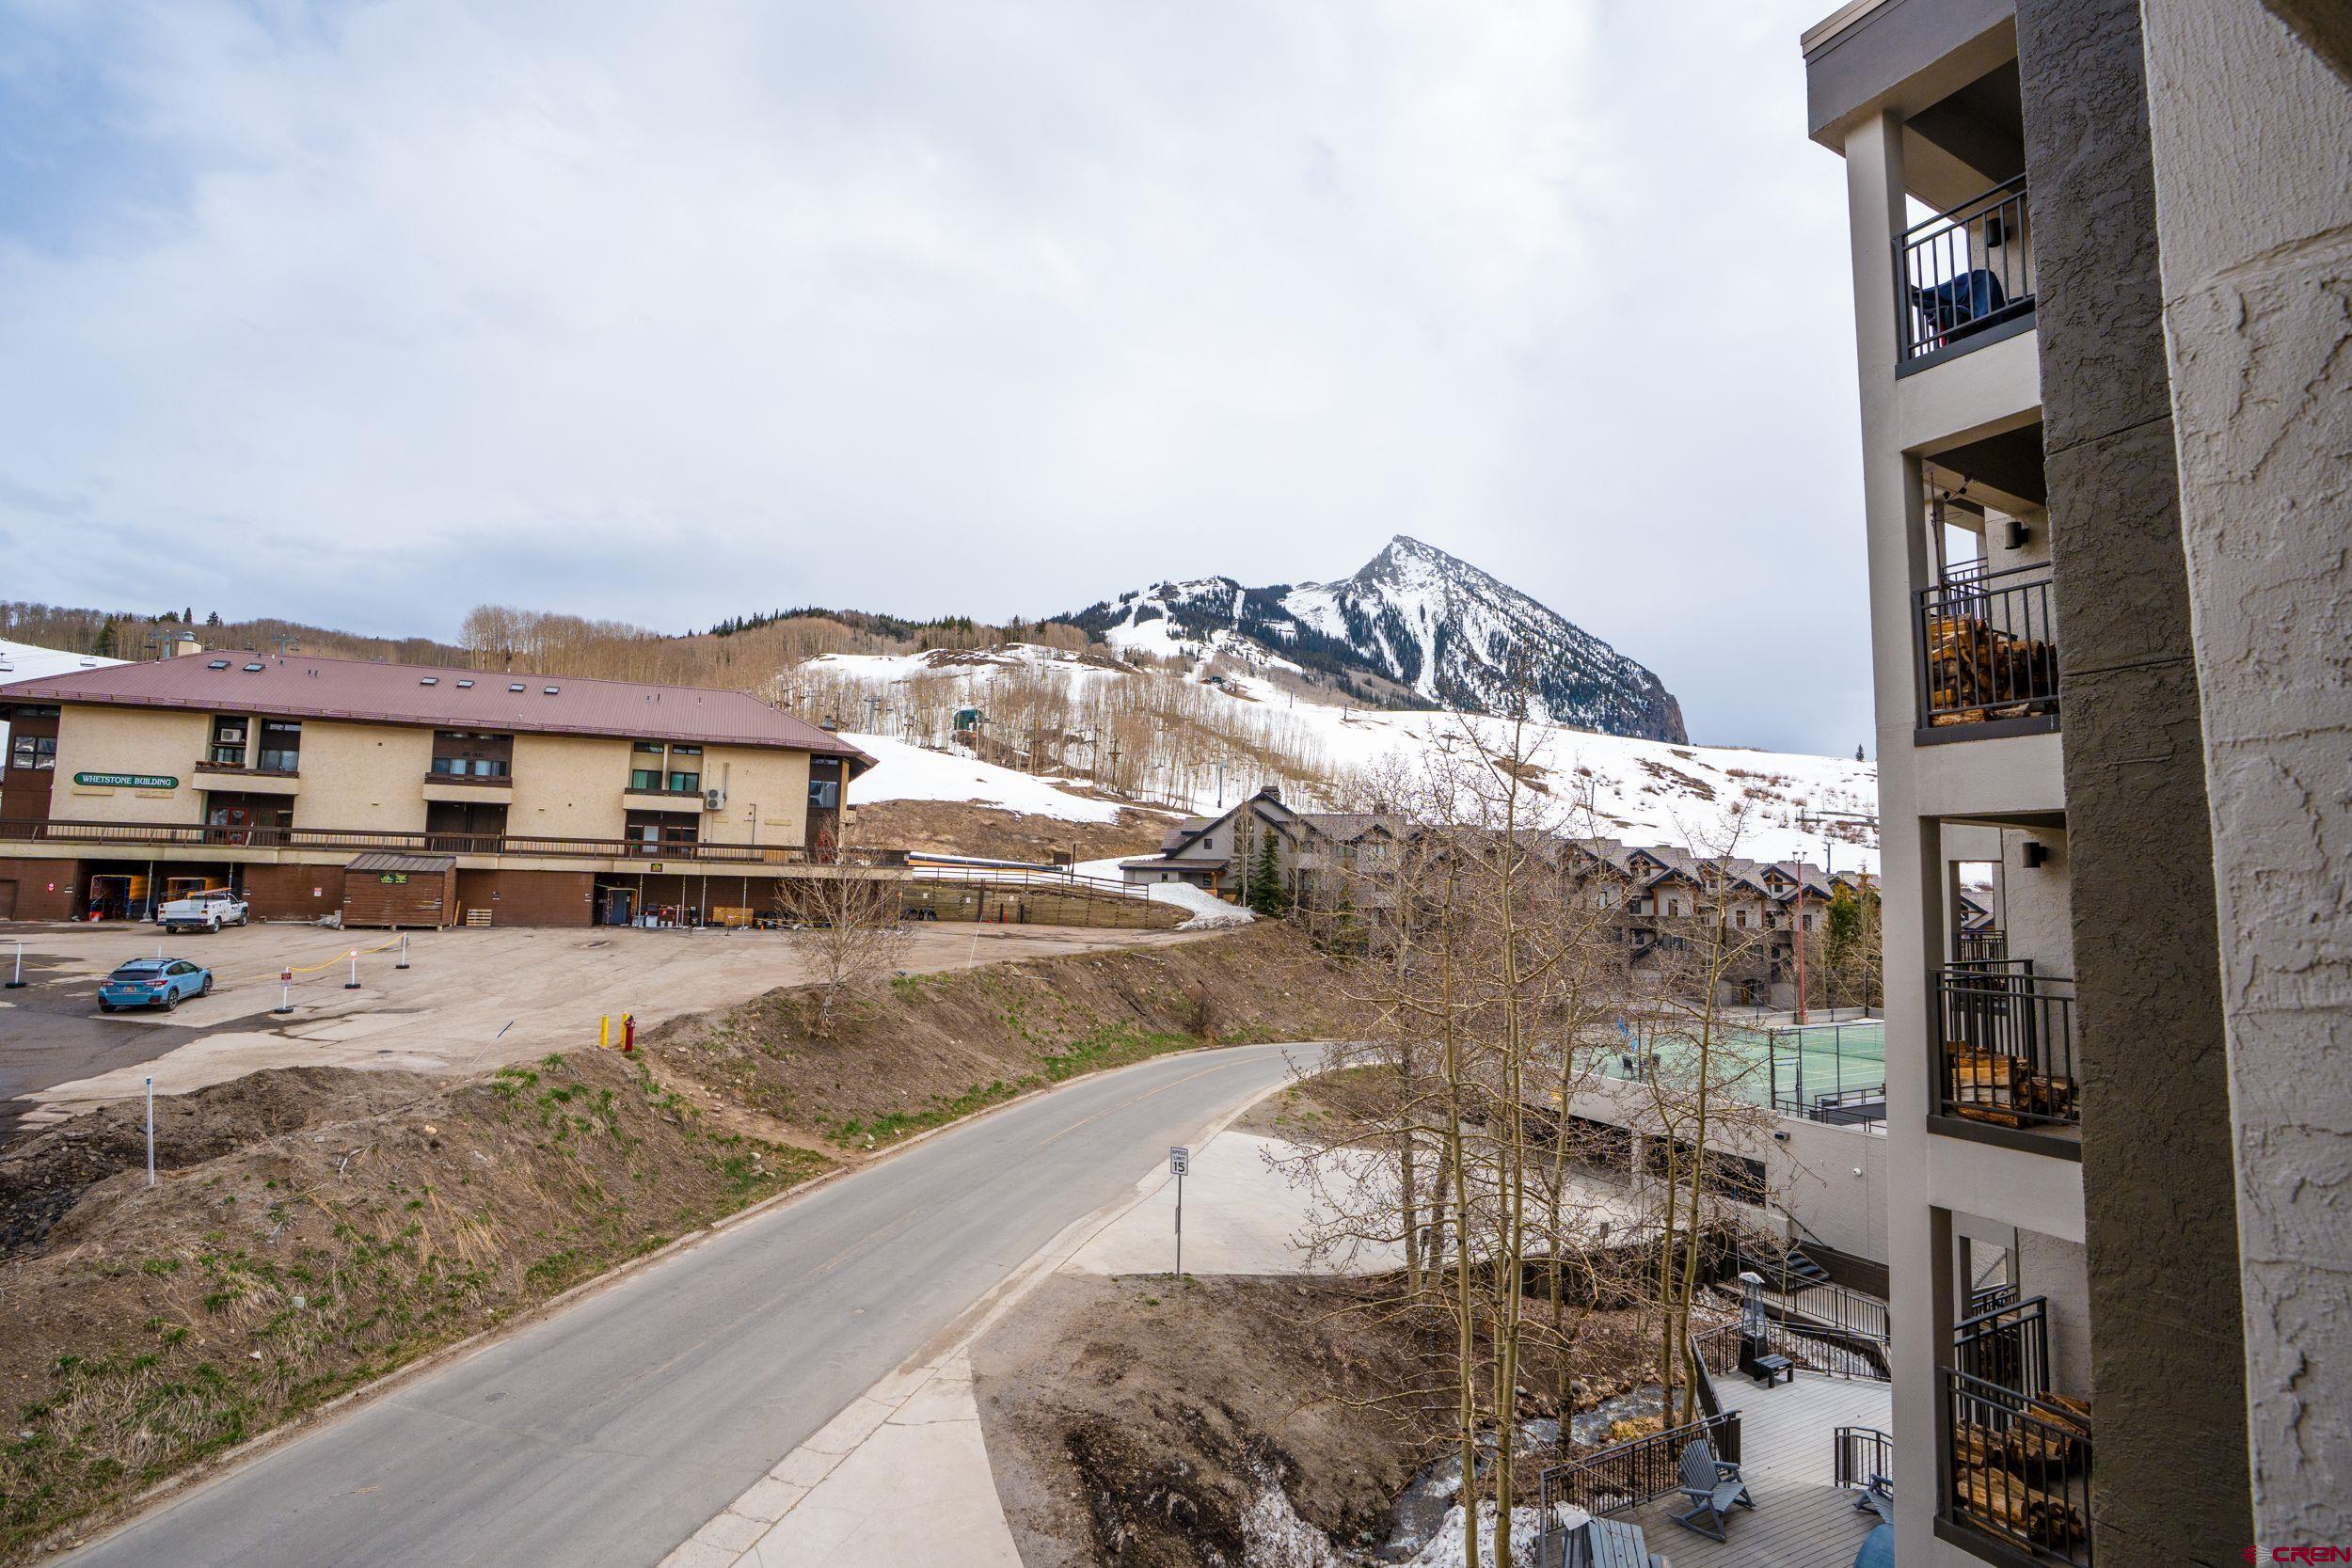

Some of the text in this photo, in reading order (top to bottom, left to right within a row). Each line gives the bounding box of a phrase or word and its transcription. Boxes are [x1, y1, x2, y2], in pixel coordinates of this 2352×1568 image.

[82, 774, 171, 786] WHETSTONE BUILDING
[1173, 1162, 1185, 1172] 15
